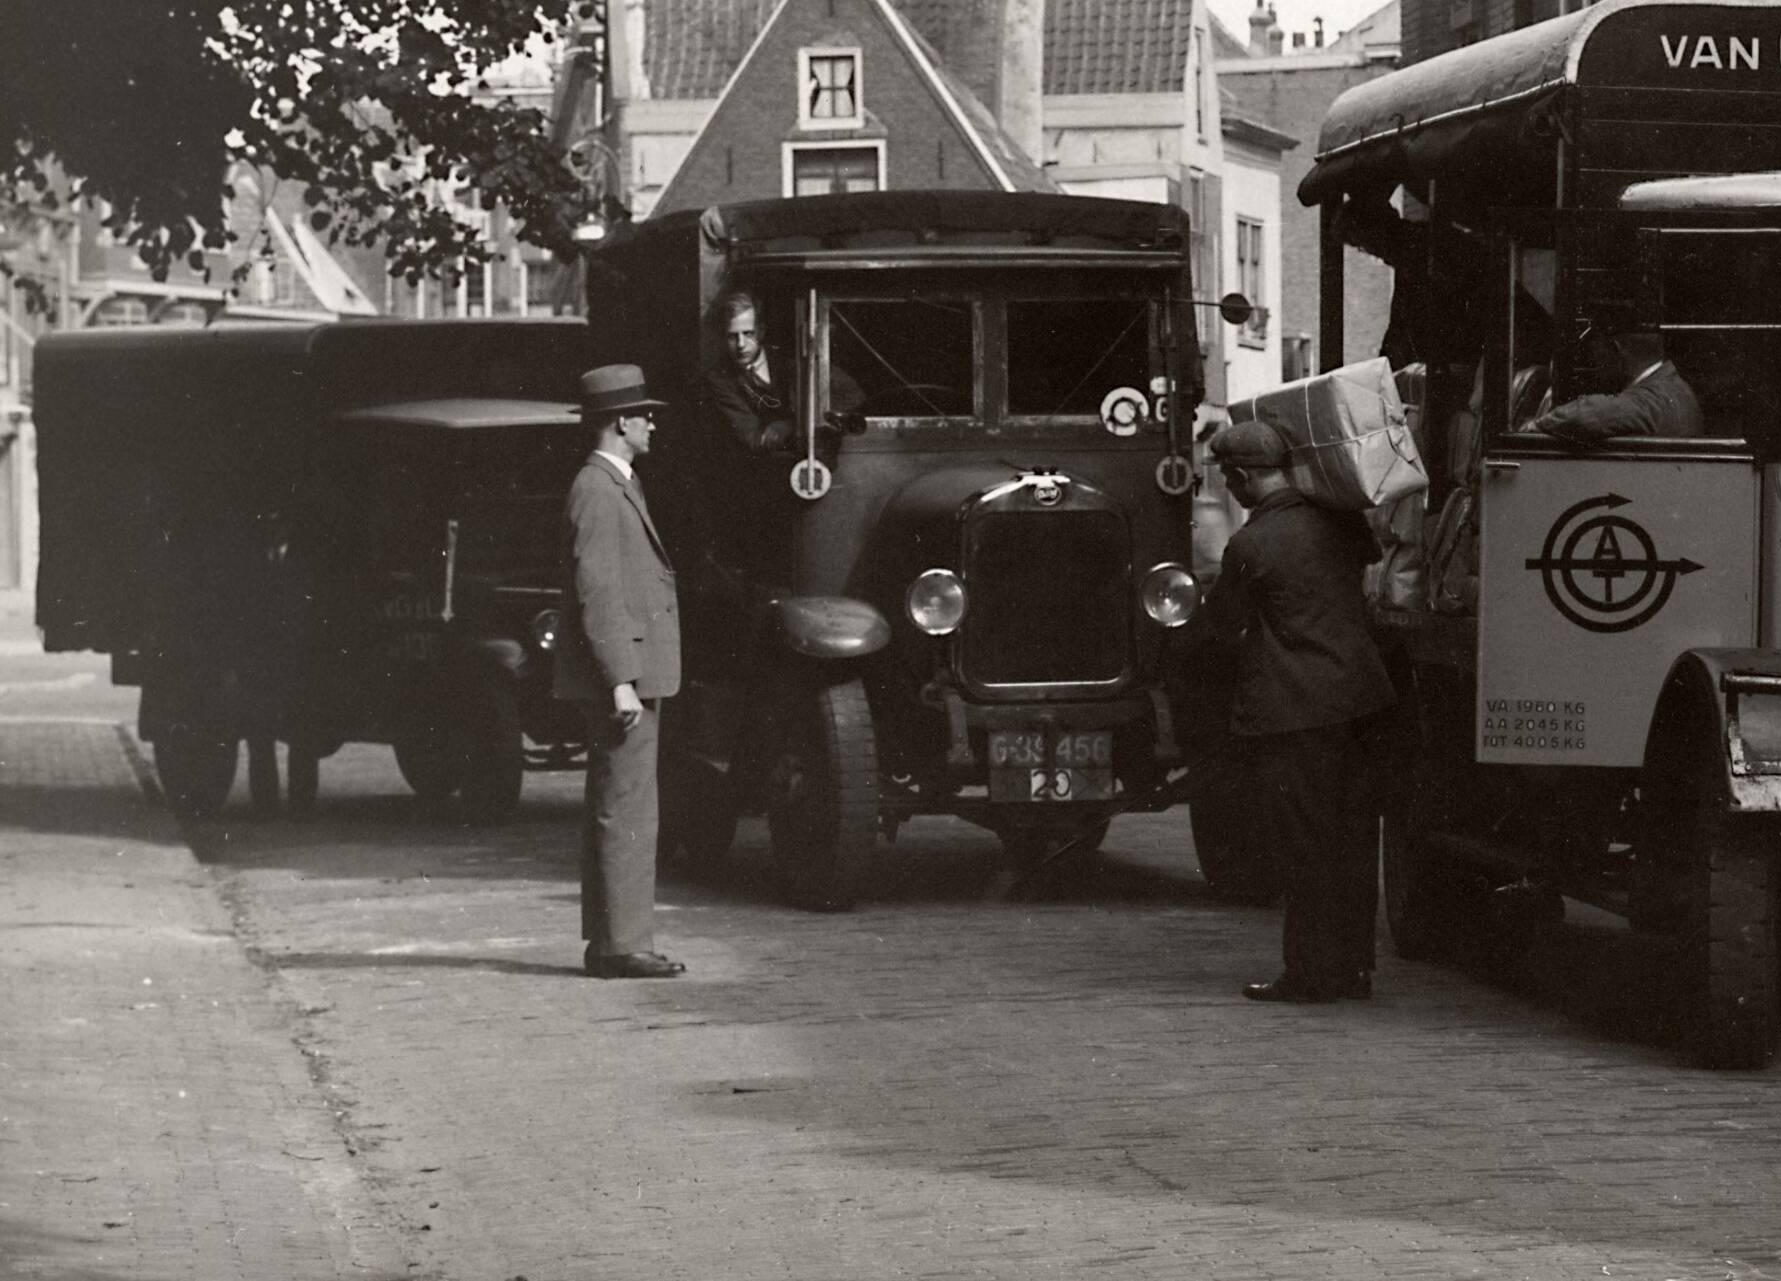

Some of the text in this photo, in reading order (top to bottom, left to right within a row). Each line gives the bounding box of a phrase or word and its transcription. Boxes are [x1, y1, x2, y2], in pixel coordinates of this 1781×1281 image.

[1660, 34, 1760, 70] VAN
[1563, 700, 1585, 714] KG
[1514, 718, 1559, 731] 2045
[1563, 718, 1585, 732] KG
[1513, 735, 1559, 748] 4005
[1563, 735, 1586, 749] KG
[1032, 769, 1071, 798] 20
